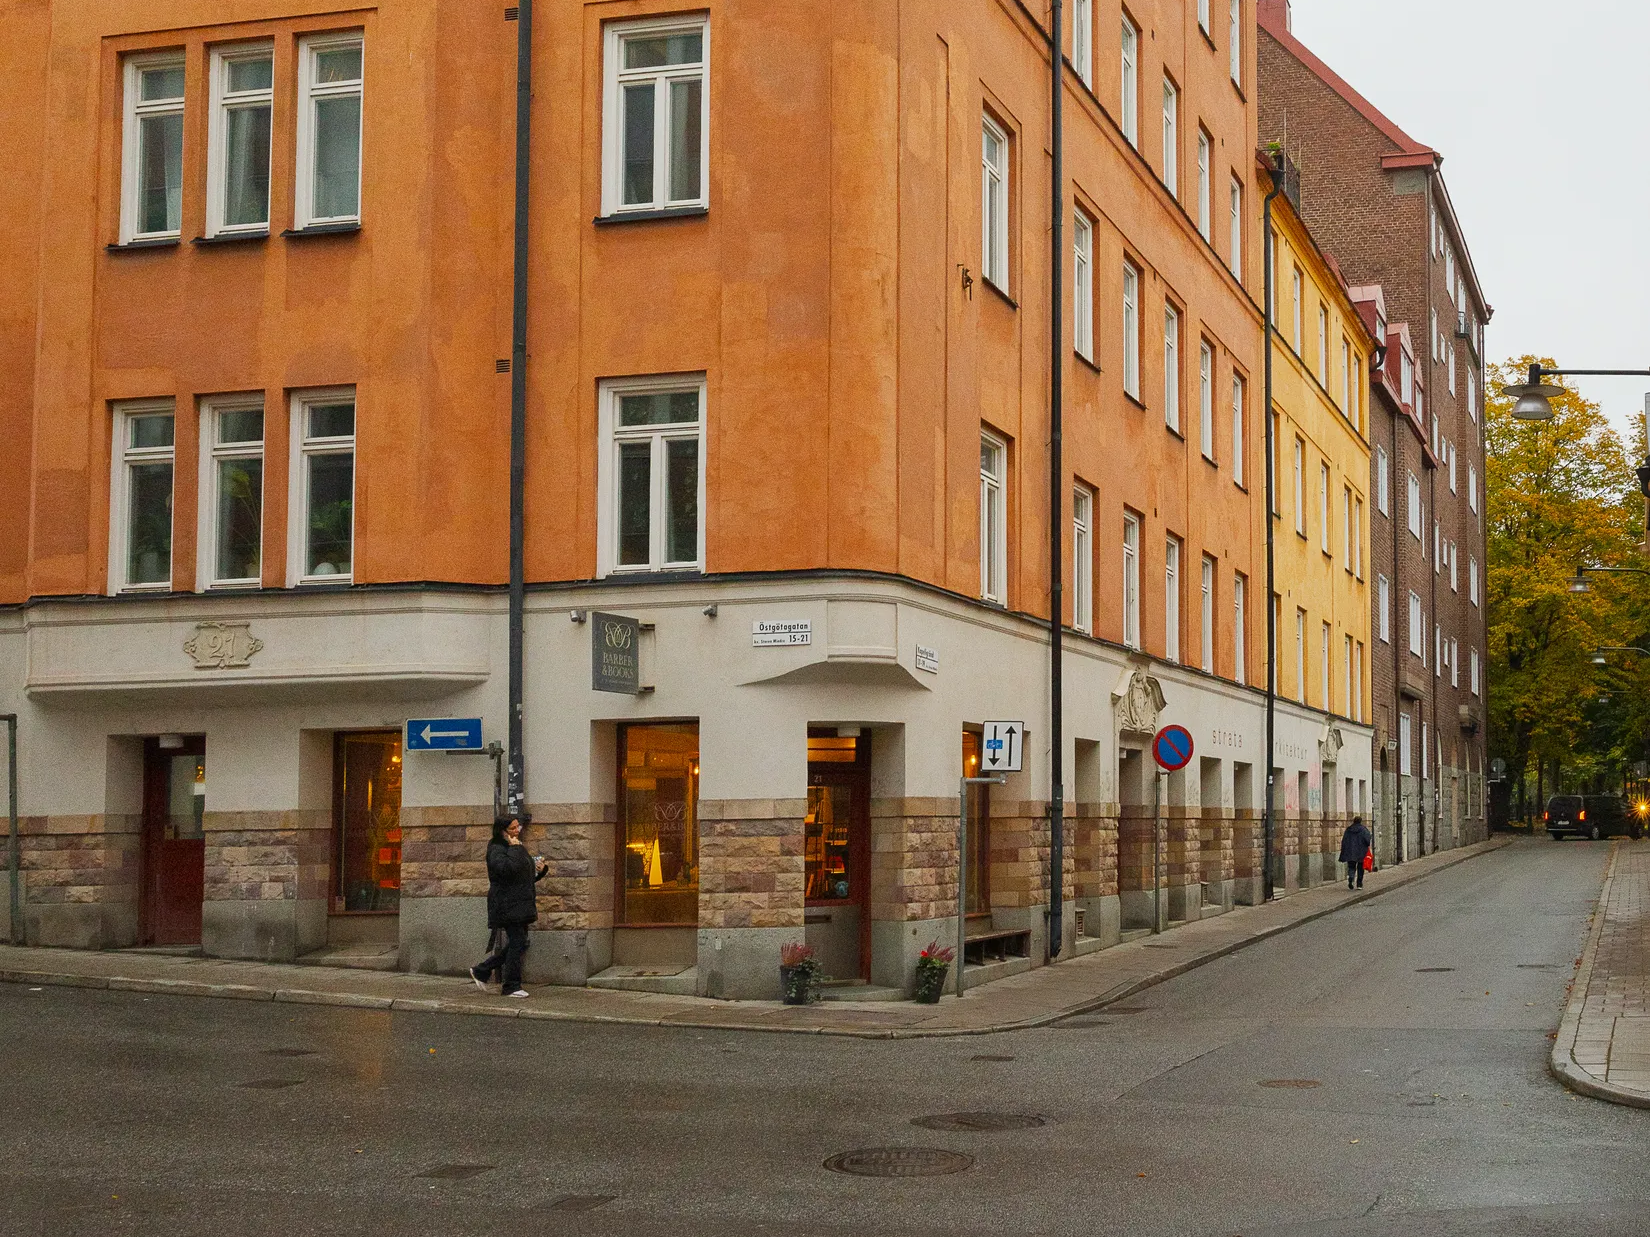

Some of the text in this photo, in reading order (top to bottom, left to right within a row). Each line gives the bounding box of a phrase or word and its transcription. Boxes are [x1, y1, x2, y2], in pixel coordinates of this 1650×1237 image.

[759, 621, 808, 633] Östgötagatan
[208, 631, 236, 660] 21
[789, 634, 808, 643] 15-21
[603, 652, 632, 666] BARBER
[1212, 729, 1308, 760] strata rkitektur
